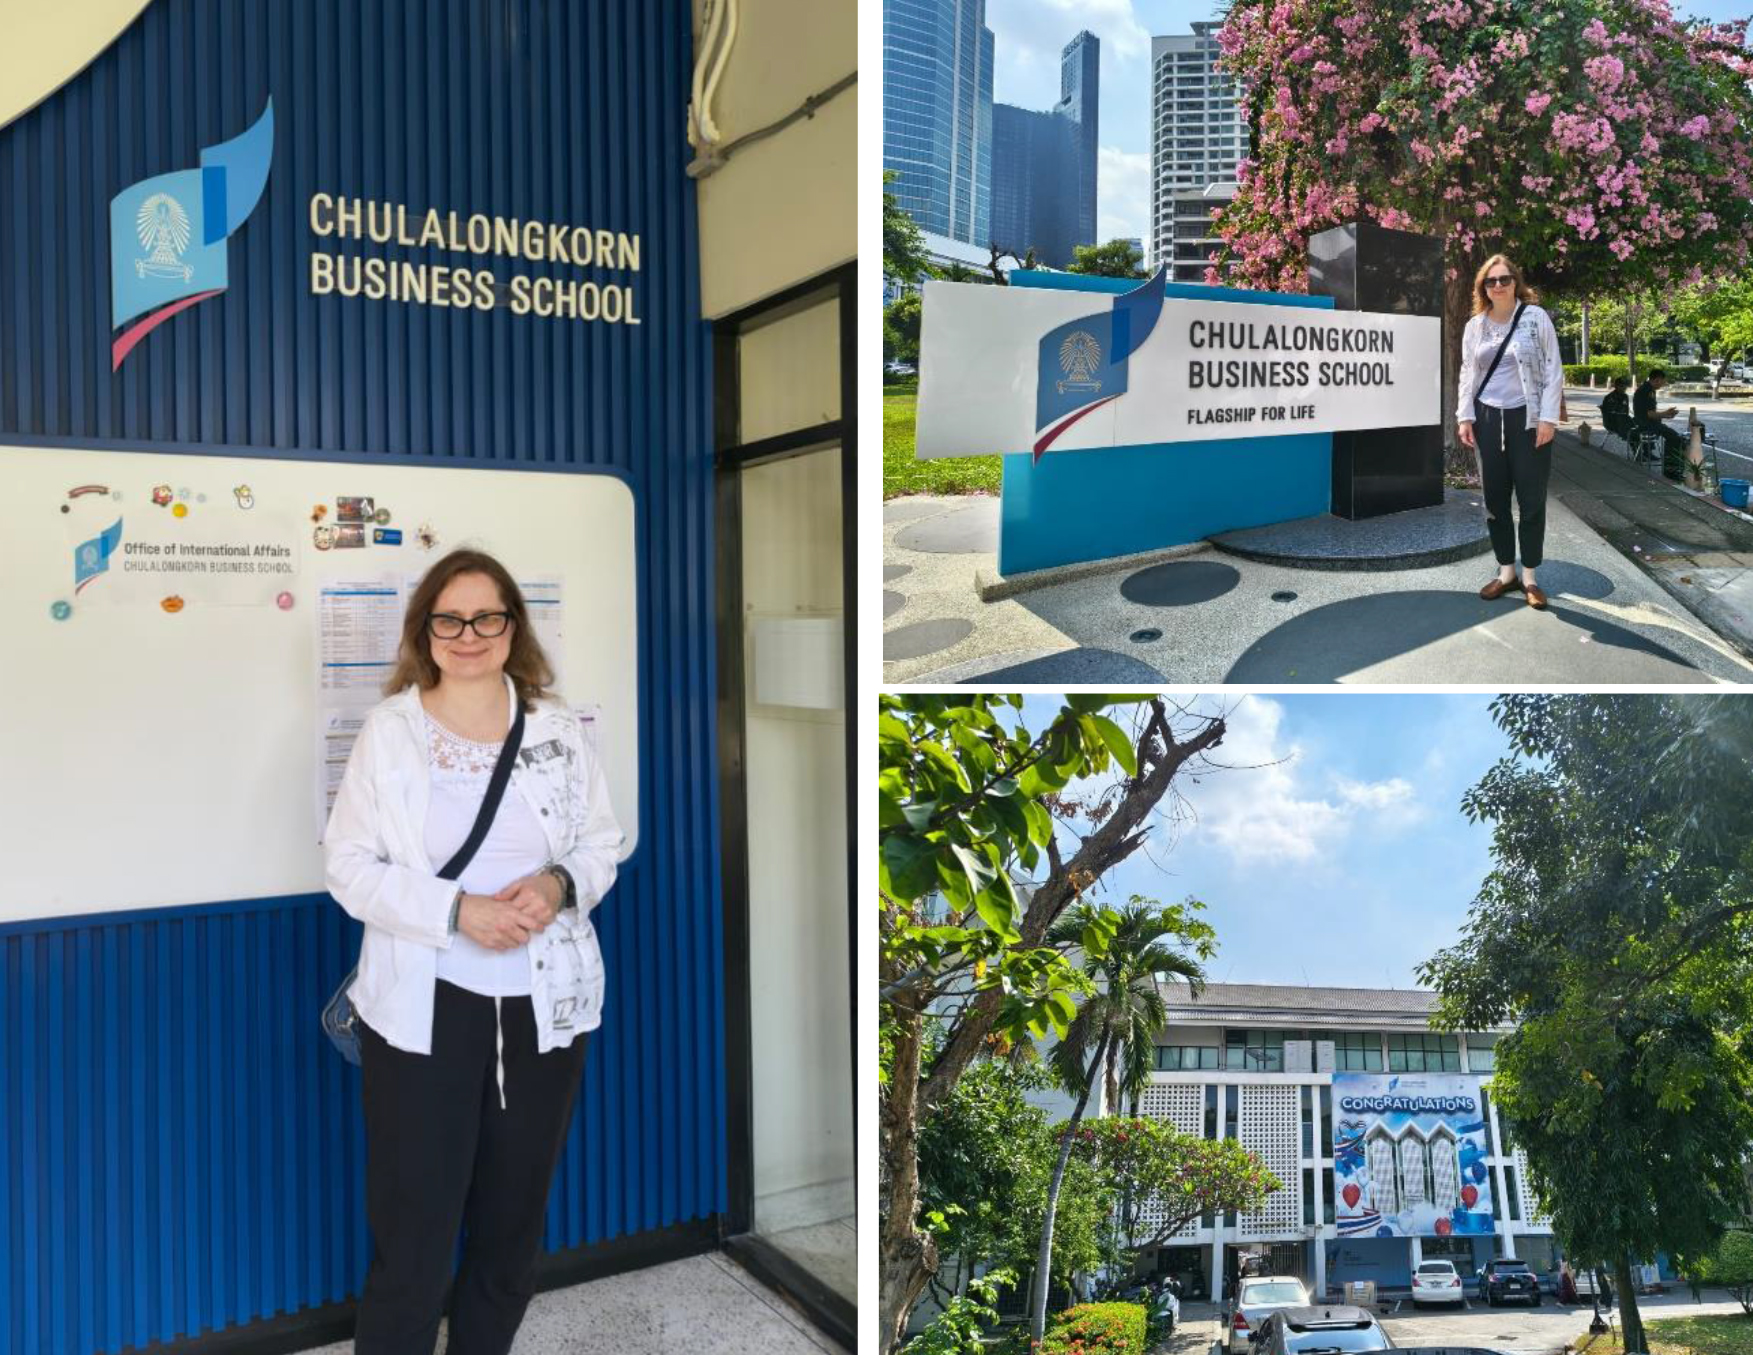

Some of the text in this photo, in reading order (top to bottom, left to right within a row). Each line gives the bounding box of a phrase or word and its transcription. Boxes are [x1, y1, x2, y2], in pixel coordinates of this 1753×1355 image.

[310, 192, 640, 272] CHULALONGKORN
[311, 252, 641, 325] BUSINESS SCHOOL
[1189, 320, 1394, 353] CHULALONGKORN
[1188, 360, 1394, 388] BUSINESS SCHOOL
[1187, 405, 1315, 424] FLAGSHIP FOR LIFE
[124, 543, 291, 557] Office of International Affairs
[124, 561, 293, 573] CHULALONGKORN BUSINESS SCHOOL
[1342, 1095, 1474, 1111] CONGRATULATIONS
